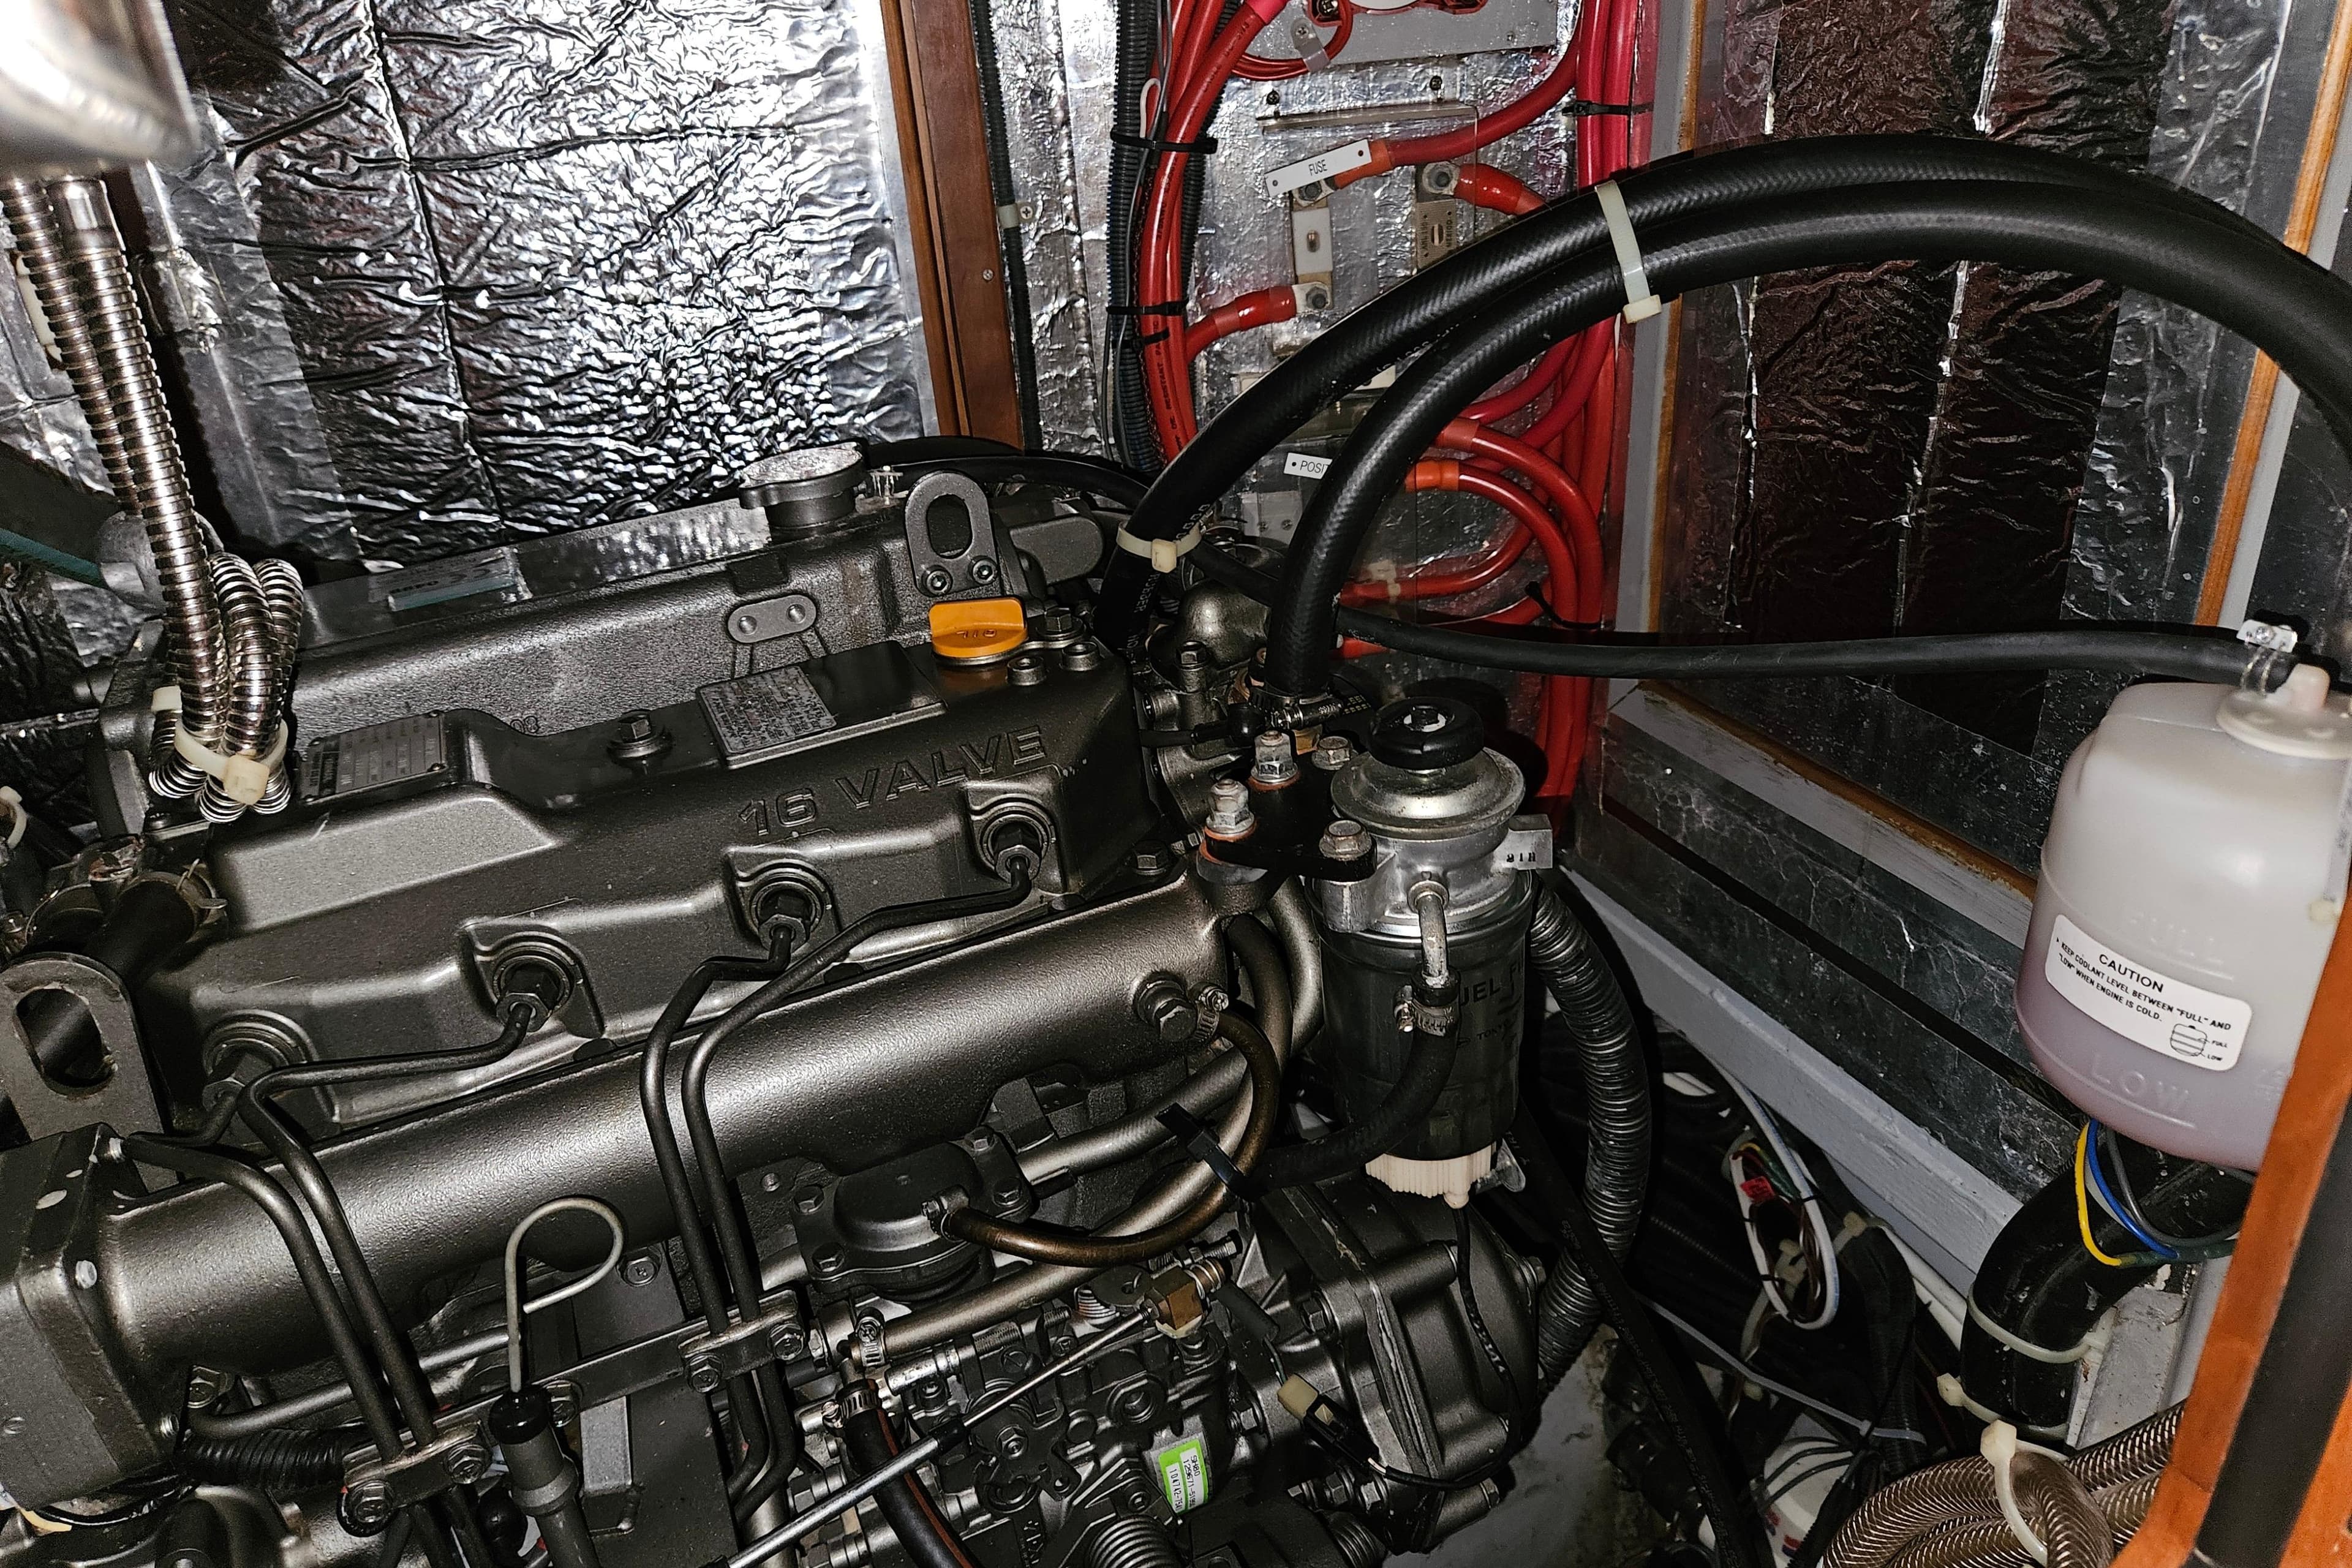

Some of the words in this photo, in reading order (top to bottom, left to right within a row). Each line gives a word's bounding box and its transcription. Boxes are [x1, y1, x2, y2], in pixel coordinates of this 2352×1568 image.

[1308, 159, 1328, 176] FUSE
[956, 629, 997, 639] OIL
[739, 786, 817, 836] 16
[835, 724, 1047, 809] VALVE
[2059, 953, 2076, 970] "LOW"
[2076, 968, 2095, 986] WHEN
[2095, 982, 2124, 1003] ENGINE
[2125, 999, 2134, 1009] IS
[2136, 1005, 2163, 1022] COLD.
[2061, 942, 2075, 957] KEEP
[2075, 954, 2105, 979] COOLANT
[2106, 975, 2130, 995] LEVEL
[2132, 989, 2174, 1013] BETWEEN
[2176, 1008, 2209, 1024] "FULL"
[2210, 1019, 2232, 1031] AND
[2099, 954, 2164, 993] CAUTION
[2212, 1039, 2229, 1048] FULL
[2089, 1055, 2191, 1112] LOW
[1190, 1455, 1201, 1476] SH80
